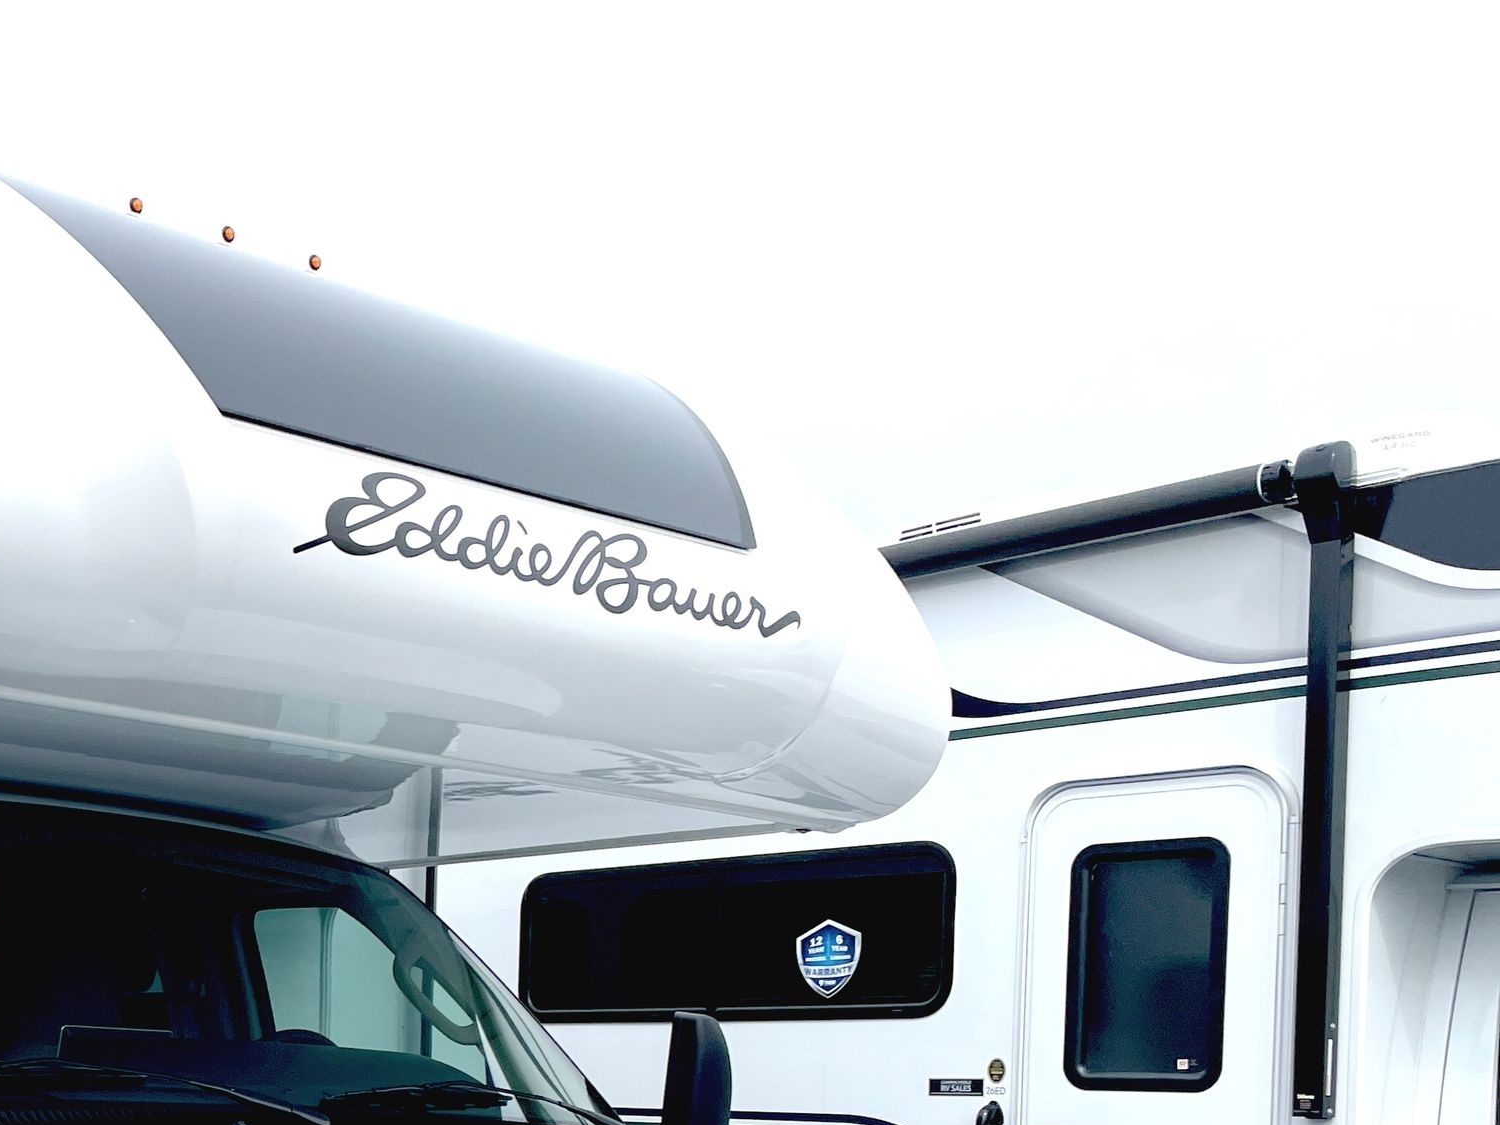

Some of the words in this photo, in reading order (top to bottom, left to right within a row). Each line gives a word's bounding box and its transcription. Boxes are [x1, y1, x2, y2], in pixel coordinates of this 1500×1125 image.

[292, 471, 574, 587] Eddie
[572, 529, 801, 638] Bauer
[809, 935, 824, 948] 12
[835, 934, 844, 945] 6
[803, 965, 853, 976] WARRANTY
[950, 1084, 972, 1092] SALES
[985, 1086, 1006, 1095] 26ED
